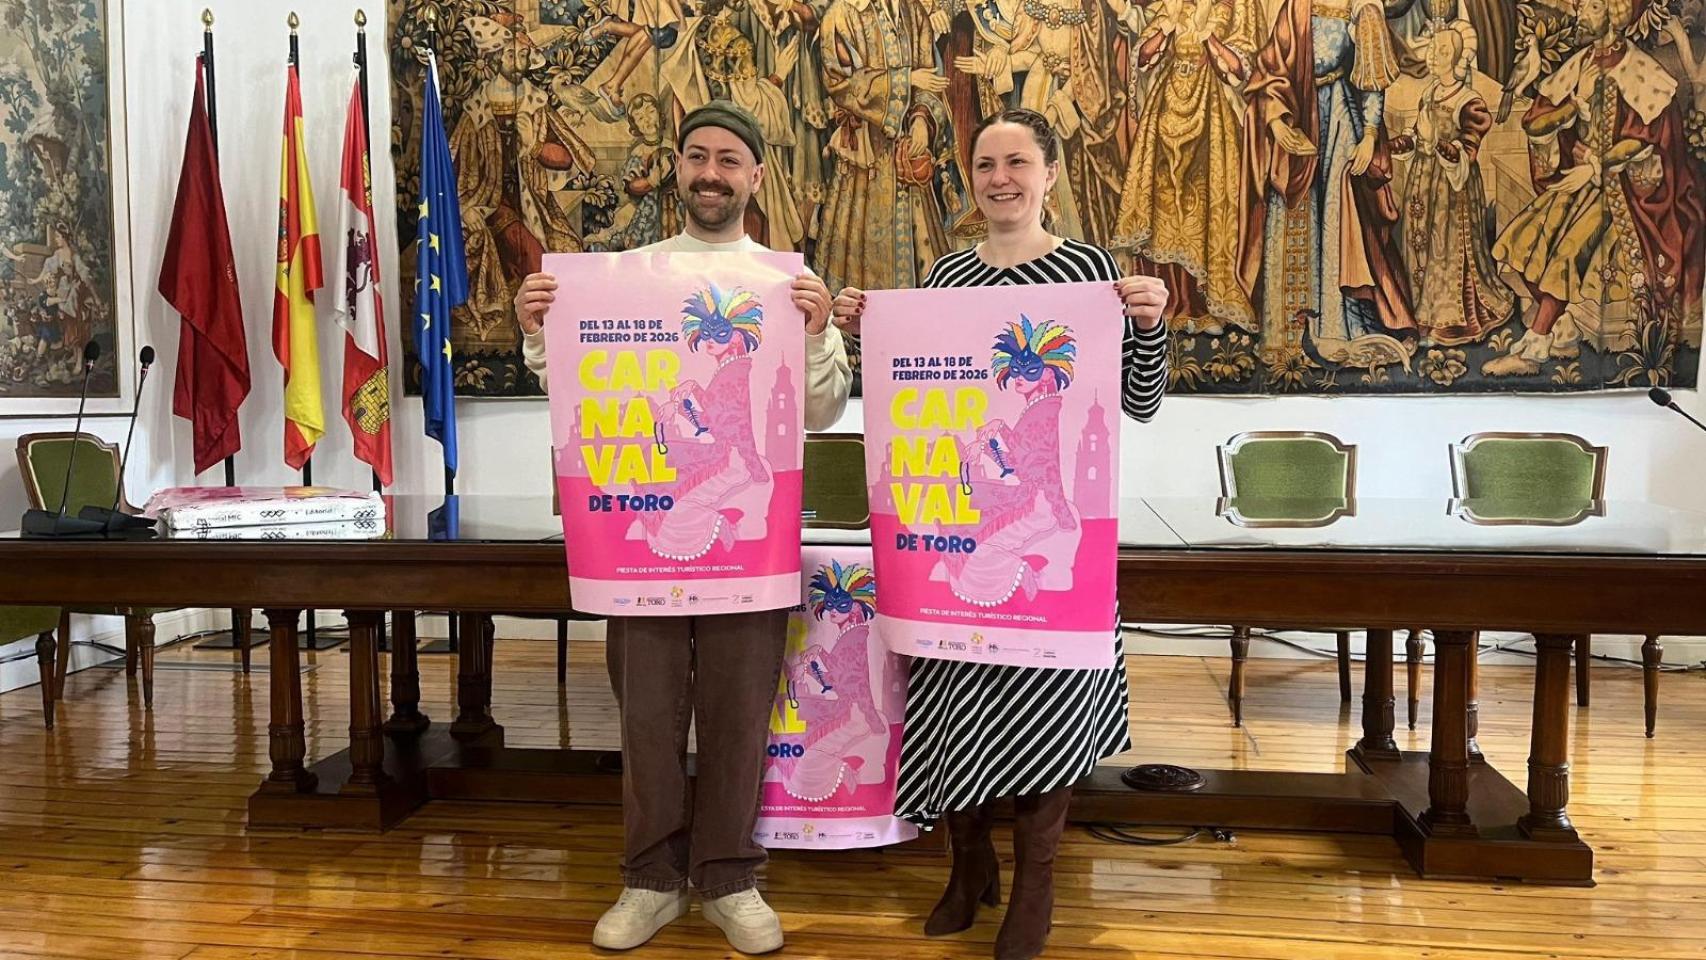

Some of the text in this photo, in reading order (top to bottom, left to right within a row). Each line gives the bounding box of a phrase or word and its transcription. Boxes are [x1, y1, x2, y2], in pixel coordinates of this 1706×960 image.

[580, 319, 663, 330] DEL 13 AL 18 DE
[580, 332, 679, 343] FEBRERO DE 2026
[578, 349, 681, 392] CAR
[893, 356, 973, 368] DEL 13 AL 18 DE
[893, 369, 988, 380] FEBRERO DE 2026
[581, 397, 656, 439] NA
[890, 386, 989, 431] CAR
[580, 444, 677, 486] VAL
[891, 435, 961, 478] NA
[589, 494, 674, 512] DE TORO
[890, 483, 981, 525] VAL
[896, 533, 977, 554] DE TORO
[951, 610, 977, 618] INTERÉS
[978, 612, 1012, 620] TURÍSTICO
[1013, 615, 1048, 623] REGIONAL
[769, 699, 807, 734] AL
[768, 743, 804, 757] ORO
